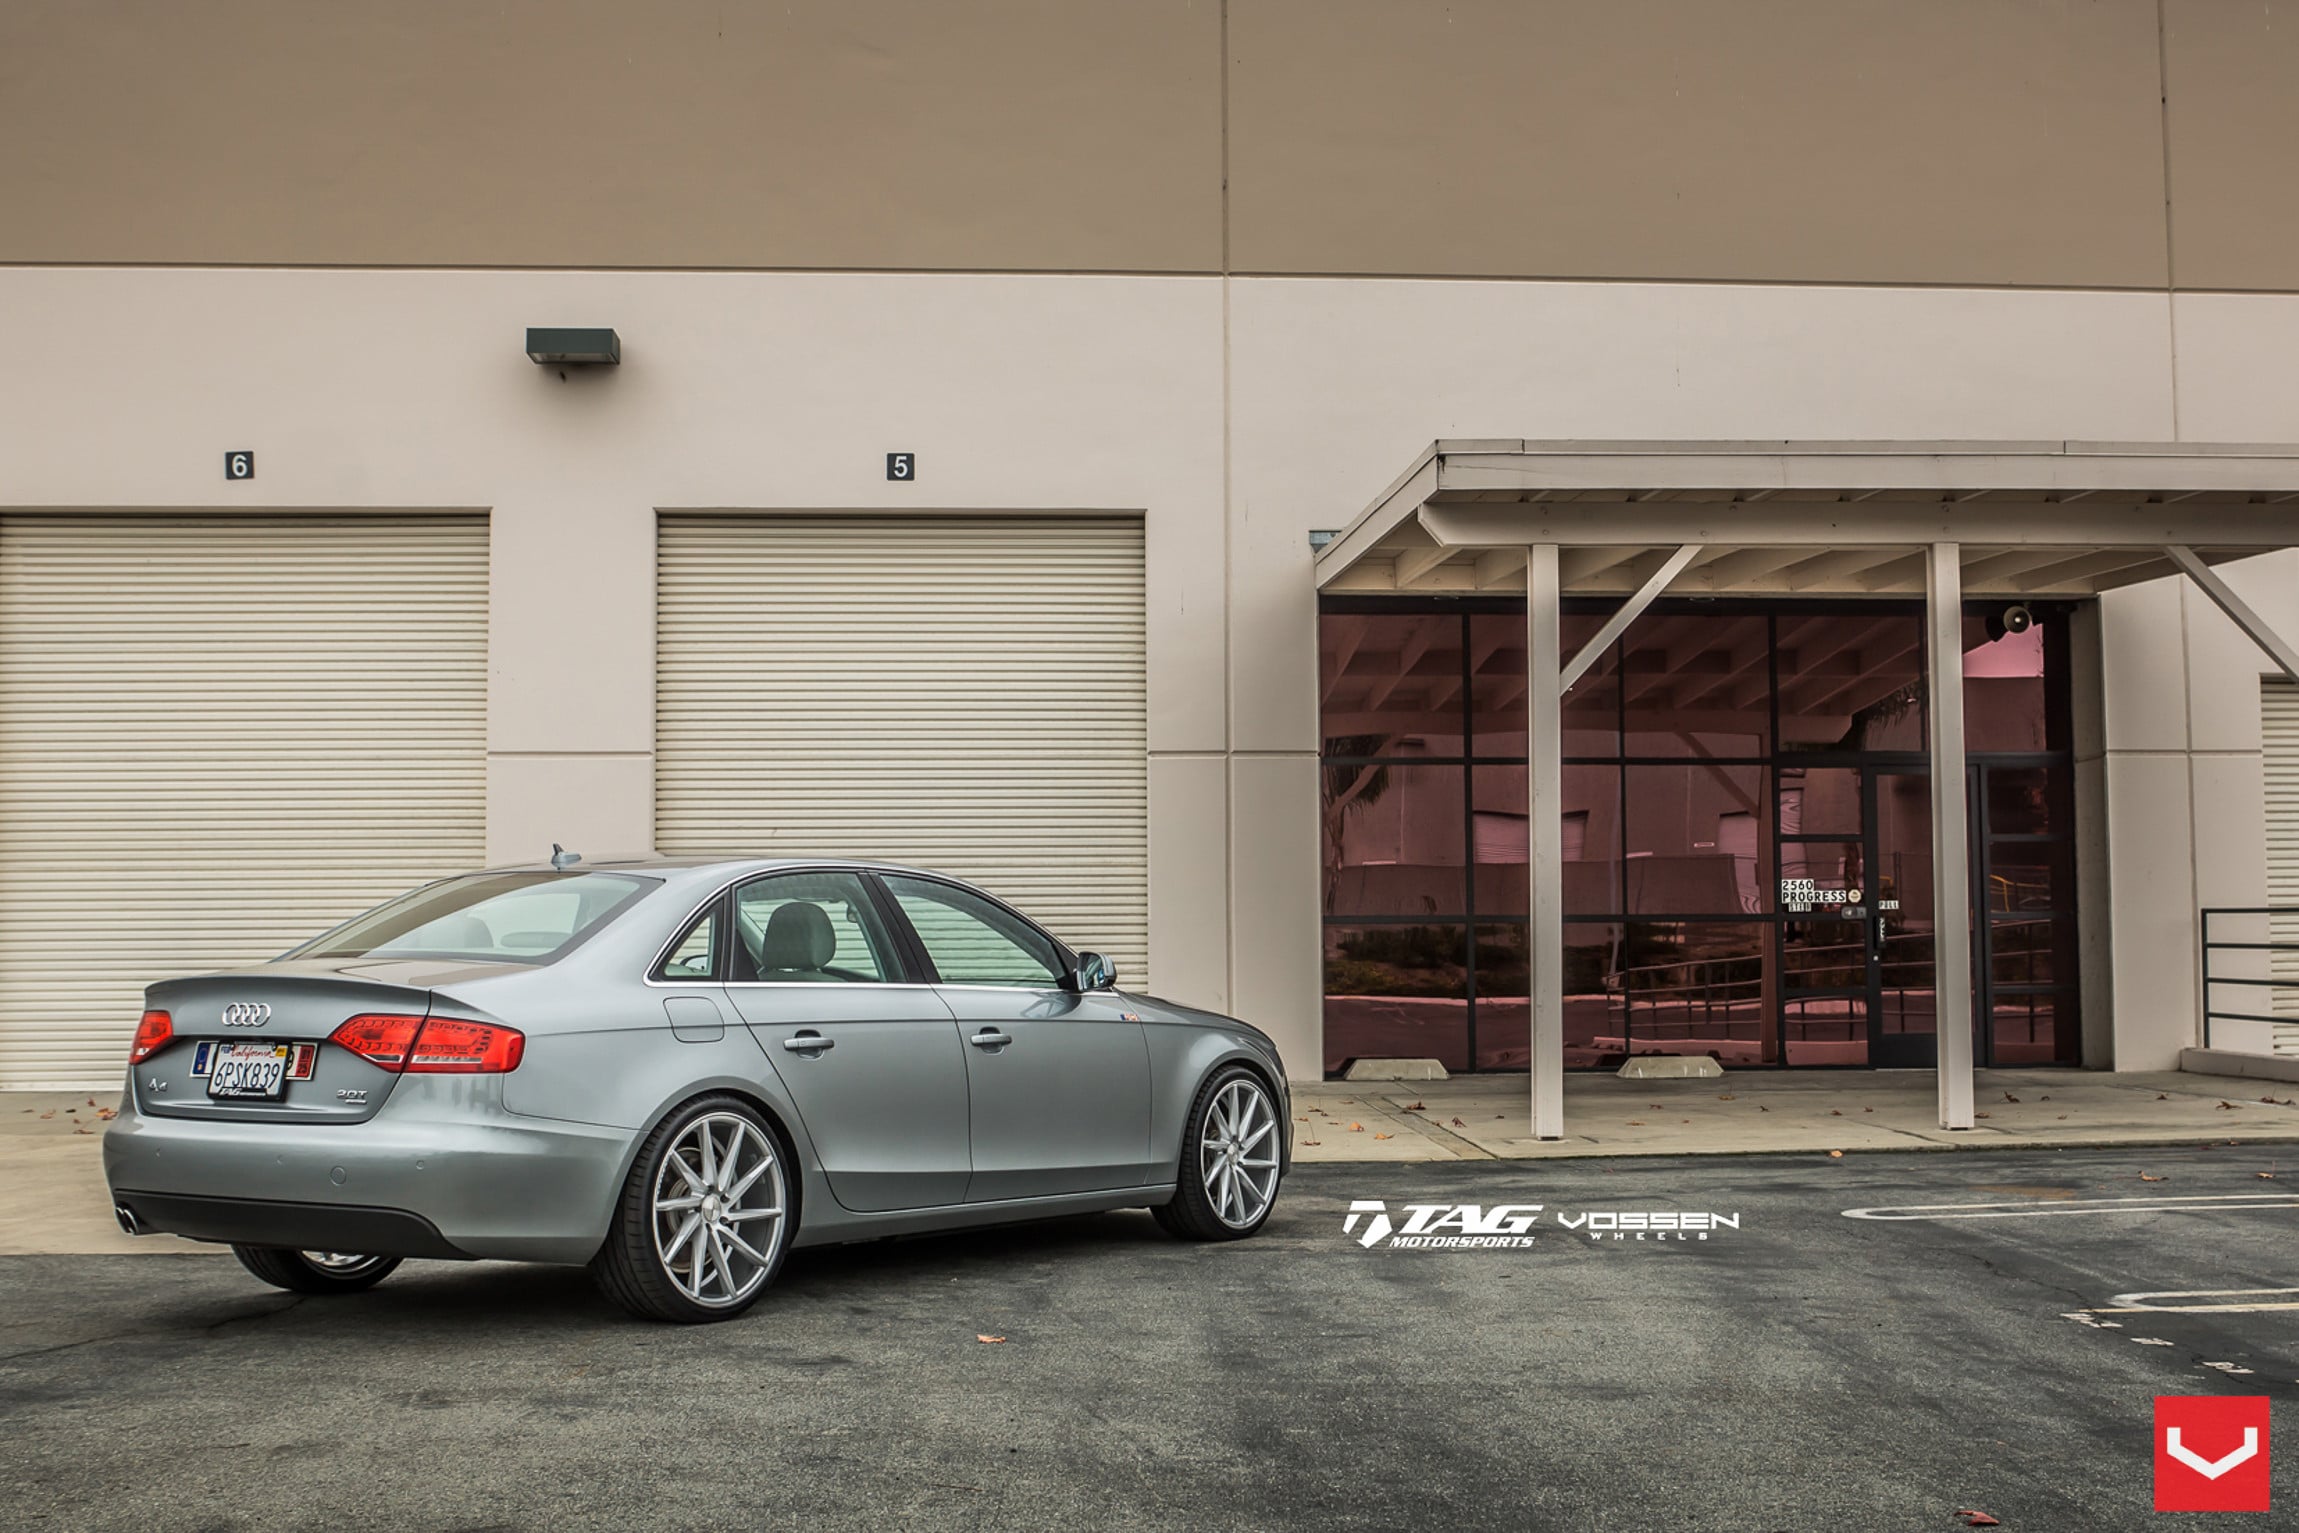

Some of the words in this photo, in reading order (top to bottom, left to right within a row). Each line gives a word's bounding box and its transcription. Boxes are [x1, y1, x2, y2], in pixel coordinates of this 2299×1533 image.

[232, 454, 248, 477] 6
[894, 455, 908, 478] 5
[1782, 880, 1813, 890] 2560
[1782, 891, 1845, 902] PROGRESS
[229, 1044, 276, 1061] California
[214, 1061, 280, 1089] 6PSK839
